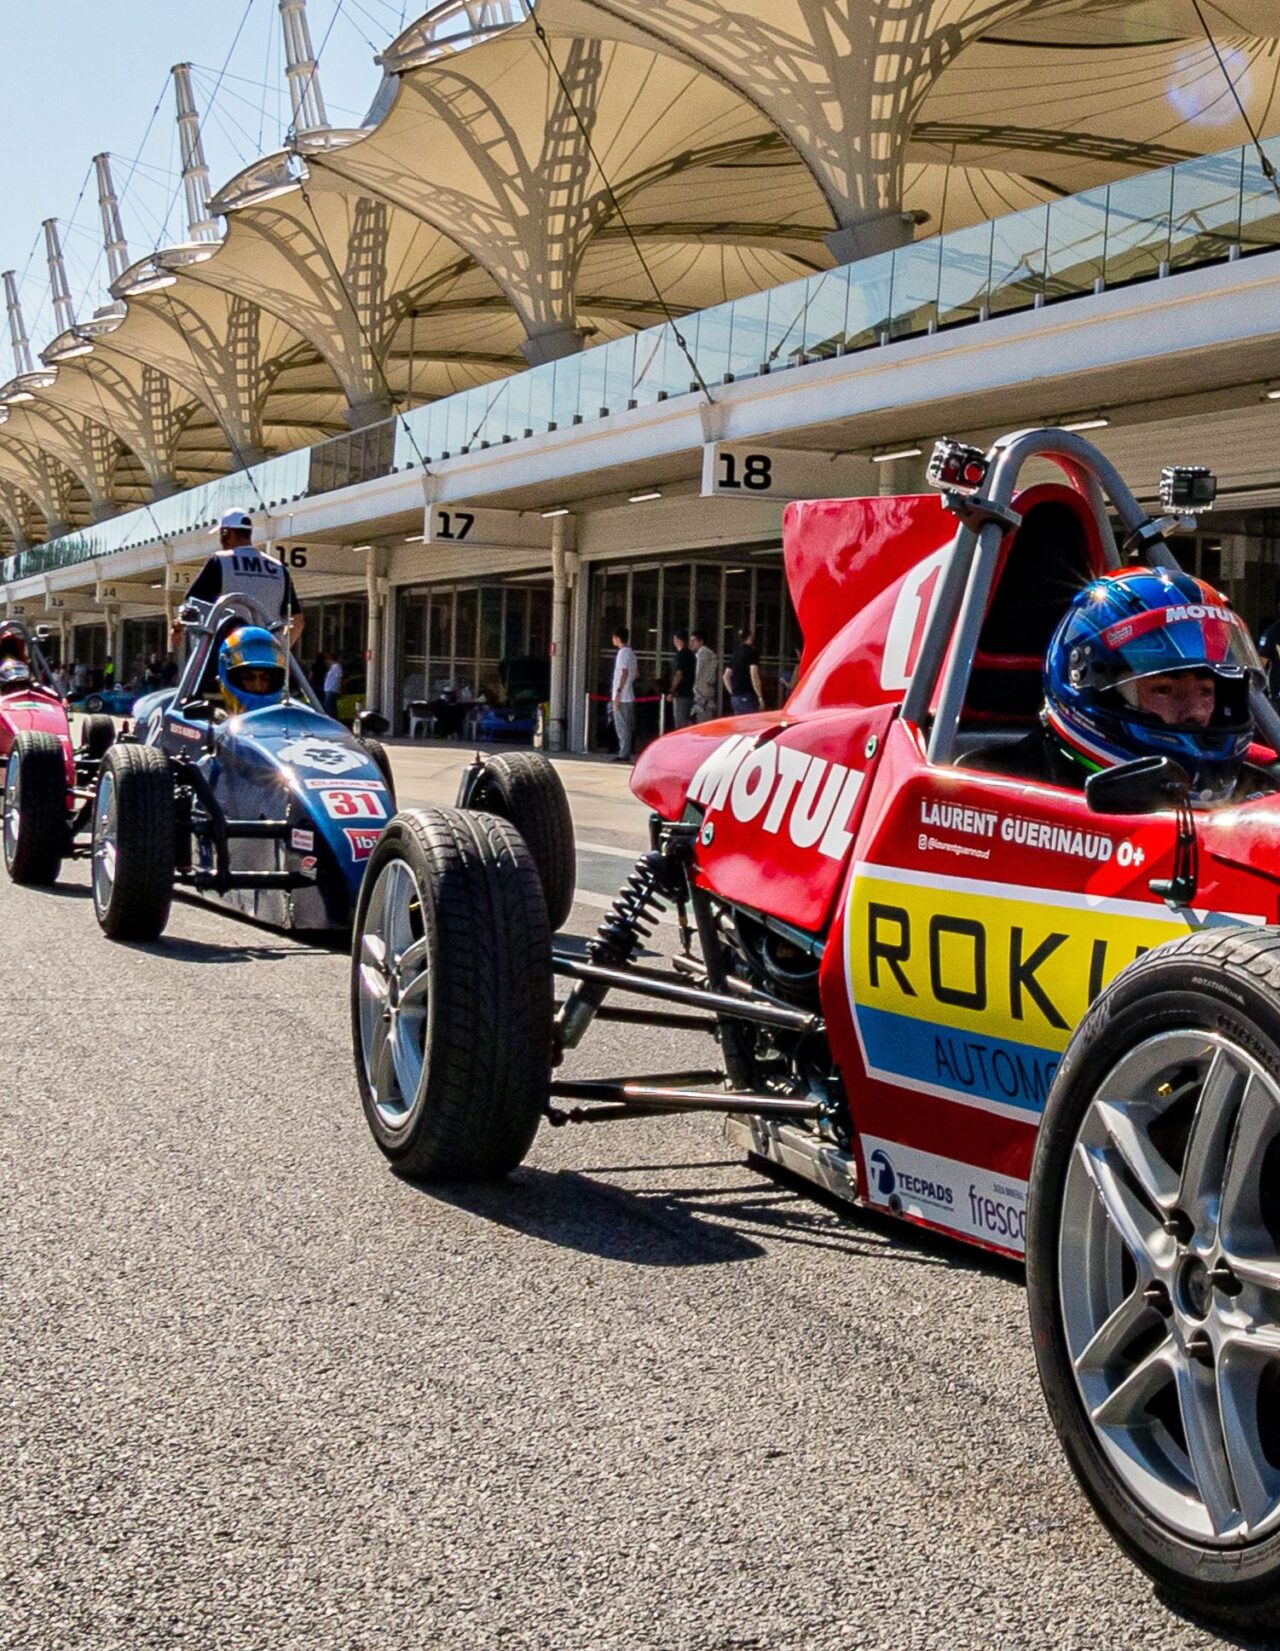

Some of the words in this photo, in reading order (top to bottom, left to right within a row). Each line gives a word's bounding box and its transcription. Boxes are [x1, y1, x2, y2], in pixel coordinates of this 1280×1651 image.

[717, 453, 773, 490] 18
[436, 511, 475, 540] 17
[232, 555, 278, 575] IMC
[275, 546, 308, 568] 16
[1166, 604, 1239, 625] MOTUL
[328, 791, 381, 816] 31
[686, 734, 866, 861] MOTUL
[920, 800, 998, 838] LAURENT
[1001, 816, 1113, 862] GUERINAUD
[867, 901, 1150, 1032] ROKI
[896, 1171, 954, 1205] TECPADS
